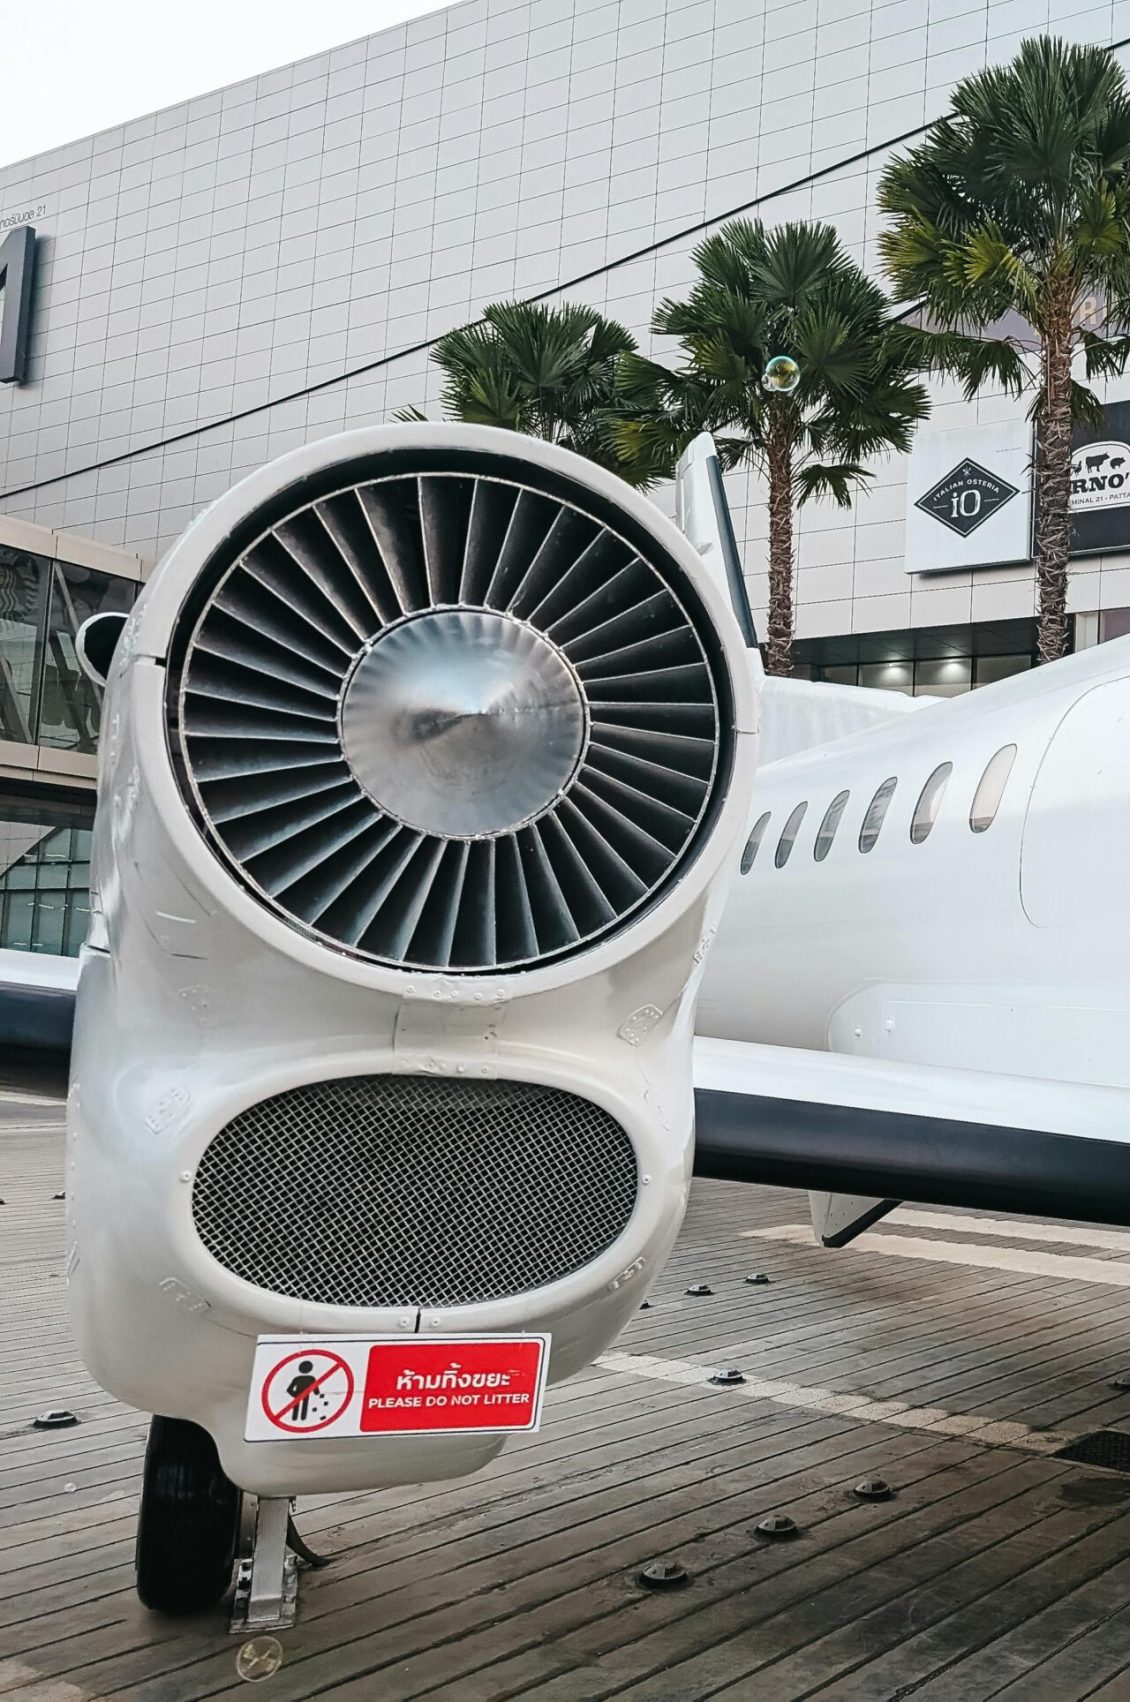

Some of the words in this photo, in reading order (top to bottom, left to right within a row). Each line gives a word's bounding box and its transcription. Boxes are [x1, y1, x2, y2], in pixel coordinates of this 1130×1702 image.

[37, 204, 46, 217] 21
[932, 481, 964, 502] ITALIAN
[966, 479, 1000, 494] OSTERIA
[1069, 497, 1094, 506] MINAL
[396, 1362, 512, 1390] ห้ามทิ้งขยะ
[368, 1397, 422, 1409] PLEASE
[425, 1395, 448, 1407] DO
[451, 1394, 481, 1406] NOT
[484, 1393, 530, 1405] LITTER
